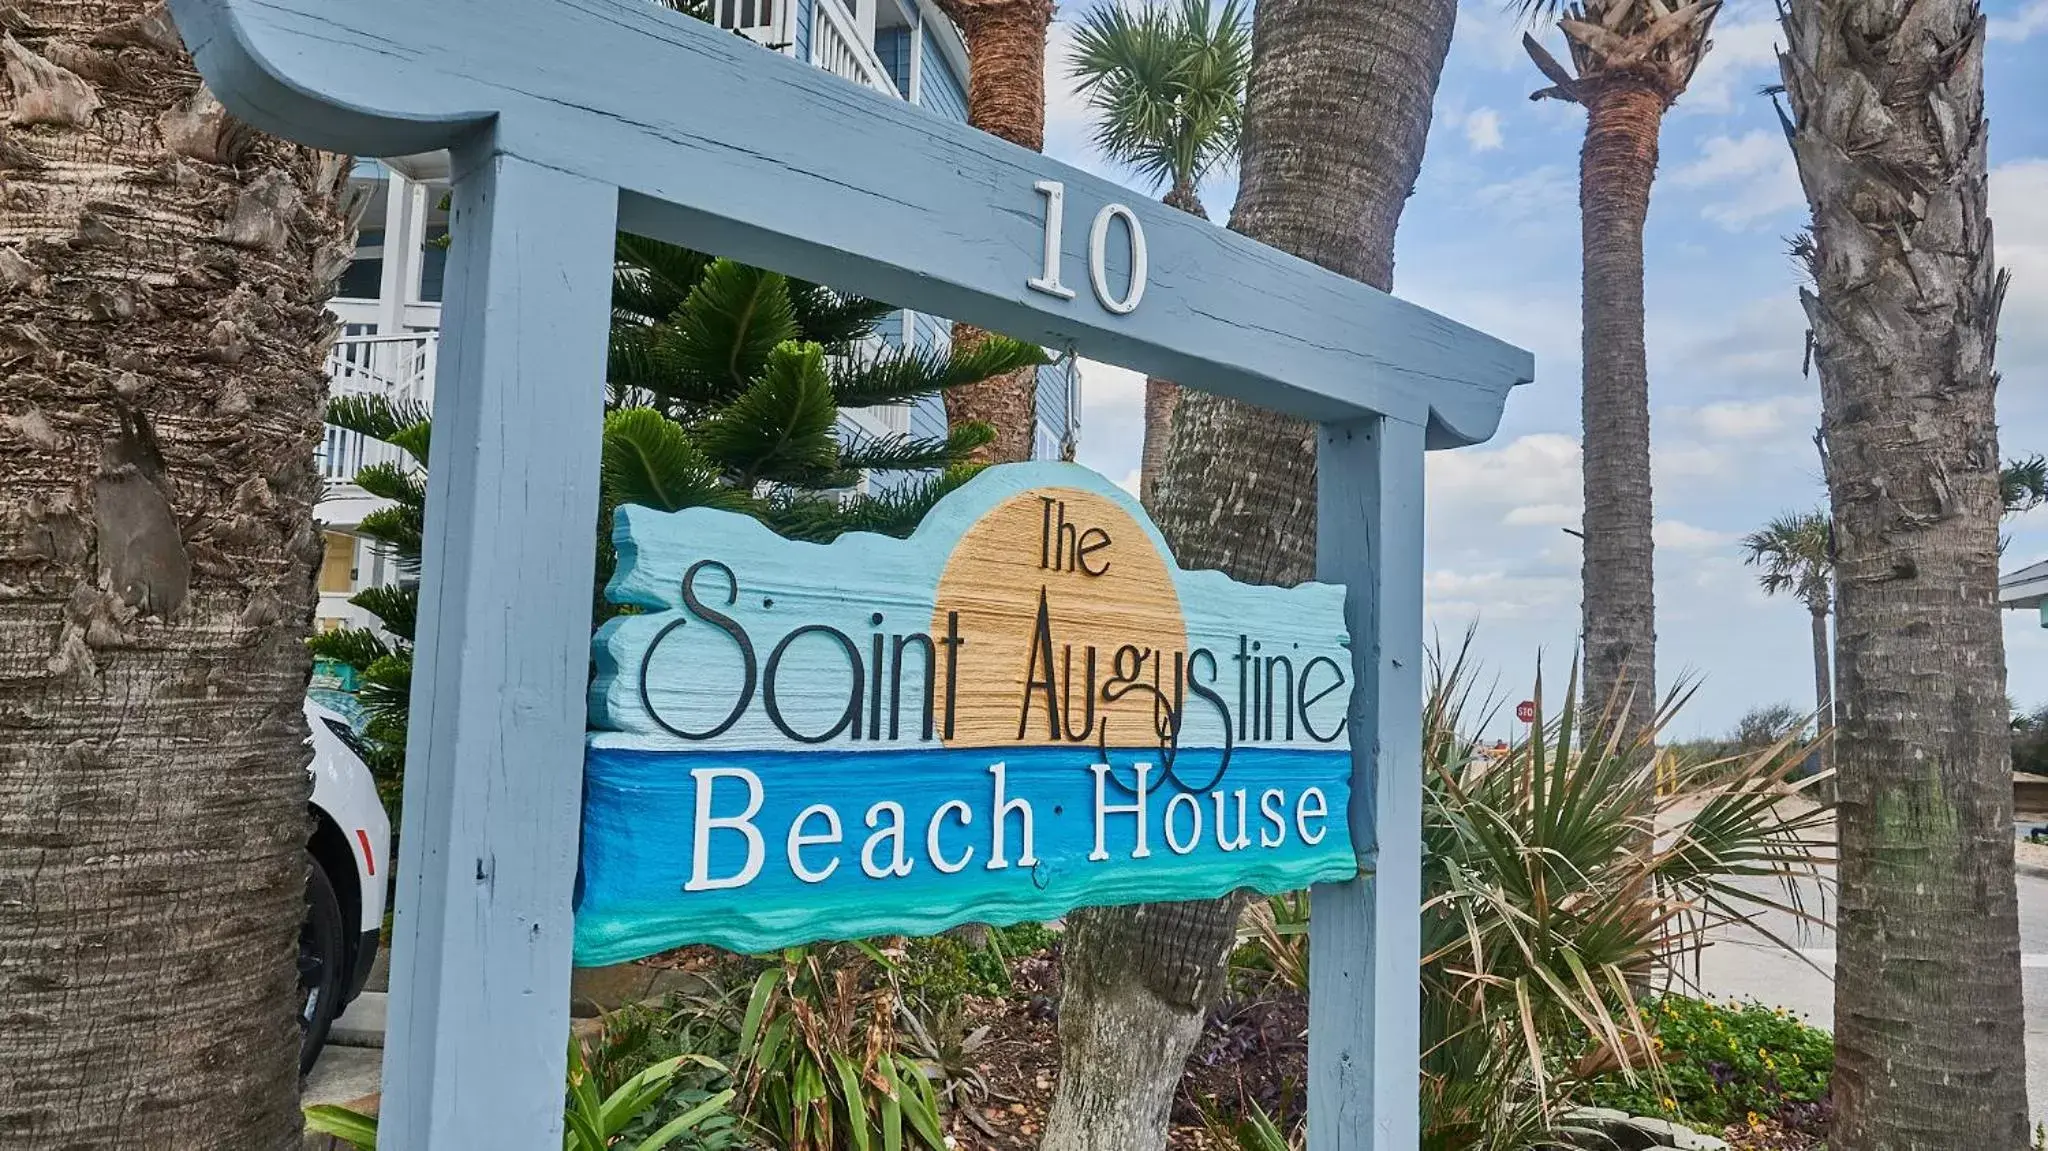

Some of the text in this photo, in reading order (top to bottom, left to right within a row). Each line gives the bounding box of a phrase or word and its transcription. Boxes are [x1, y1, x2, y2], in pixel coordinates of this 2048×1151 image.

[1027, 180, 1148, 315] 10
[1038, 496, 1112, 577] The
[640, 559, 1347, 794] Saint Augustine
[1518, 707, 1533, 717] STO
[684, 762, 1328, 892] Beach House
